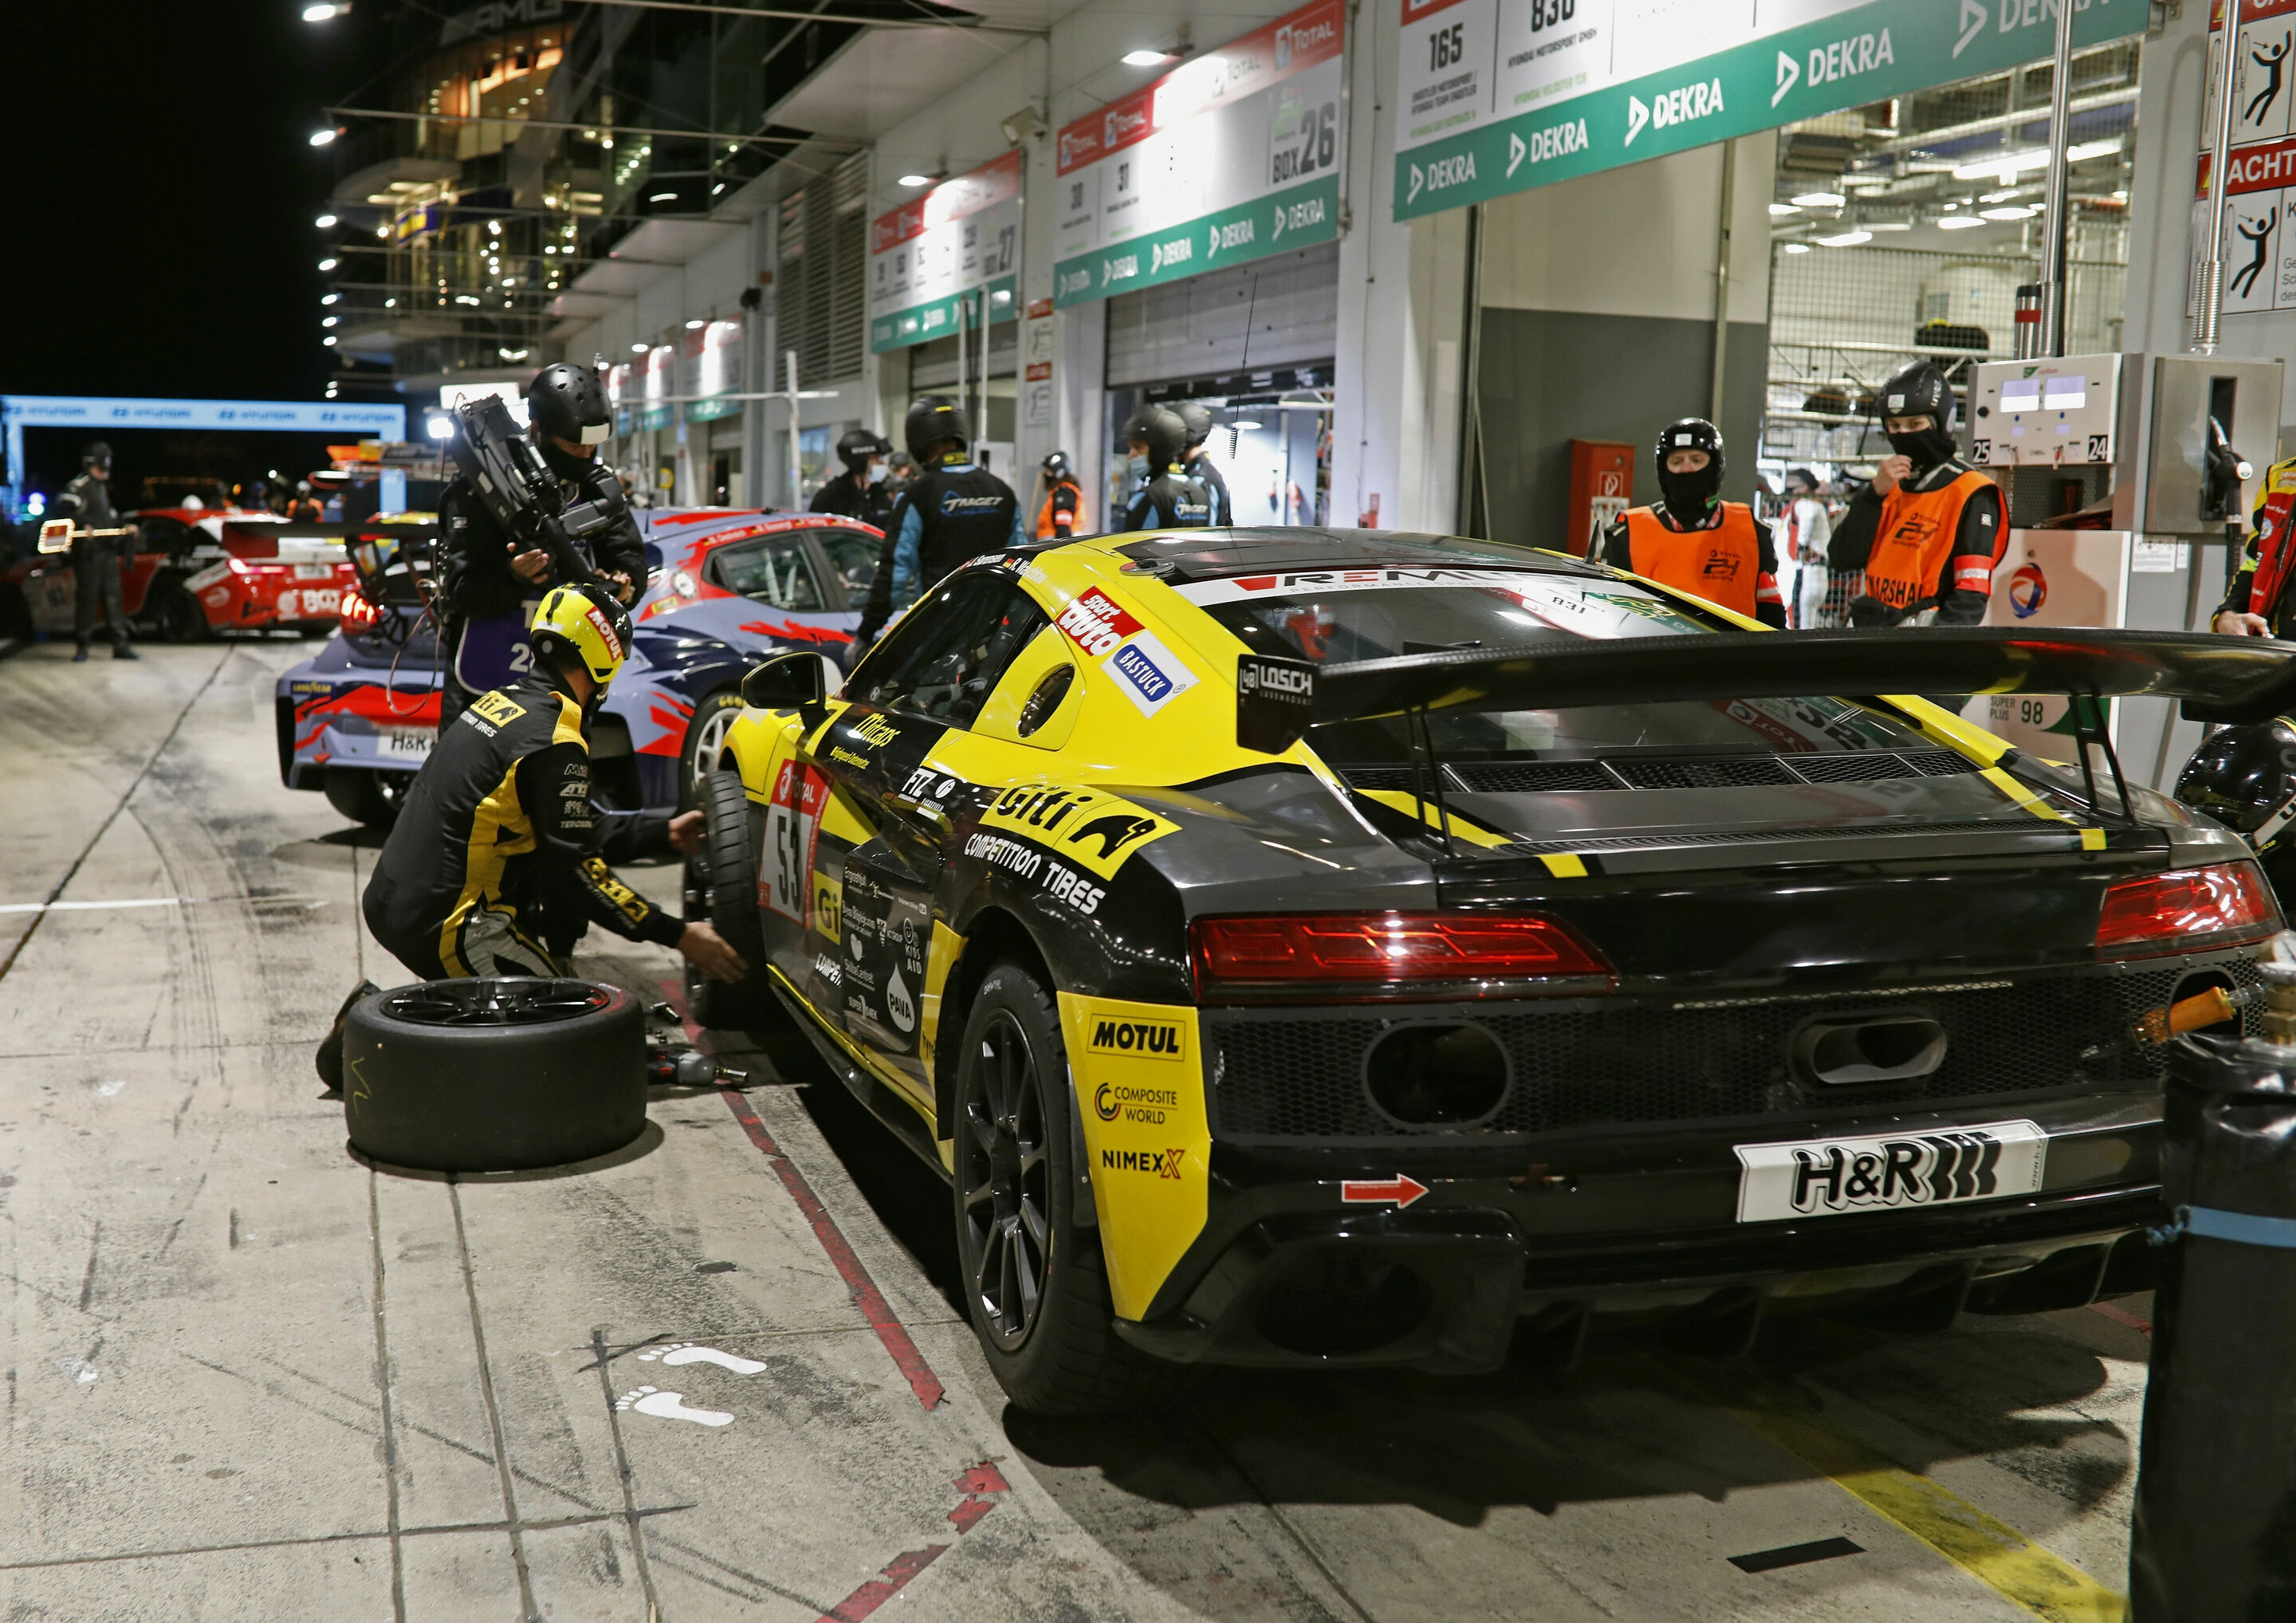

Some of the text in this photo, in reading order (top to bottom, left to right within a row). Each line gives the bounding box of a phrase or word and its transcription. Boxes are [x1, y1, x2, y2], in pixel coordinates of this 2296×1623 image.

[1292, 21, 1335, 51] TOTAL
[1429, 22, 1463, 72] 165
[1808, 27, 1894, 88] DEKRA
[1653, 77, 1724, 130] DEKRA
[1273, 101, 1335, 183] BOX 26
[1531, 118, 1589, 163] DEKRA
[1428, 152, 1476, 191] DEKRA
[1288, 198, 1325, 230] DEKRA
[1221, 218, 1254, 249] DEKRA
[1973, 441, 1990, 462] 25
[2089, 437, 2108, 461] 24
[1083, 595, 1121, 620] sport
[588, 609, 623, 660] MOTUL
[1059, 605, 1122, 656] auto
[509, 643, 536, 673] 2
[1119, 650, 1166, 696] BASTUCK
[1260, 666, 1312, 696] LOSCH
[1990, 695, 2043, 725] SUPER 98
[1990, 709, 2010, 721] PLUS
[391, 731, 426, 750] H&R
[792, 775, 814, 804] TOTAL
[997, 784, 1092, 831] Giti
[965, 833, 1106, 914] COMPETITION TIRES
[1093, 1022, 1179, 1054] MOTUL
[1115, 1087, 1177, 1105] COMPOSITE
[1126, 1108, 1166, 1125] WORLD
[1791, 1140, 1932, 1212] H&R
